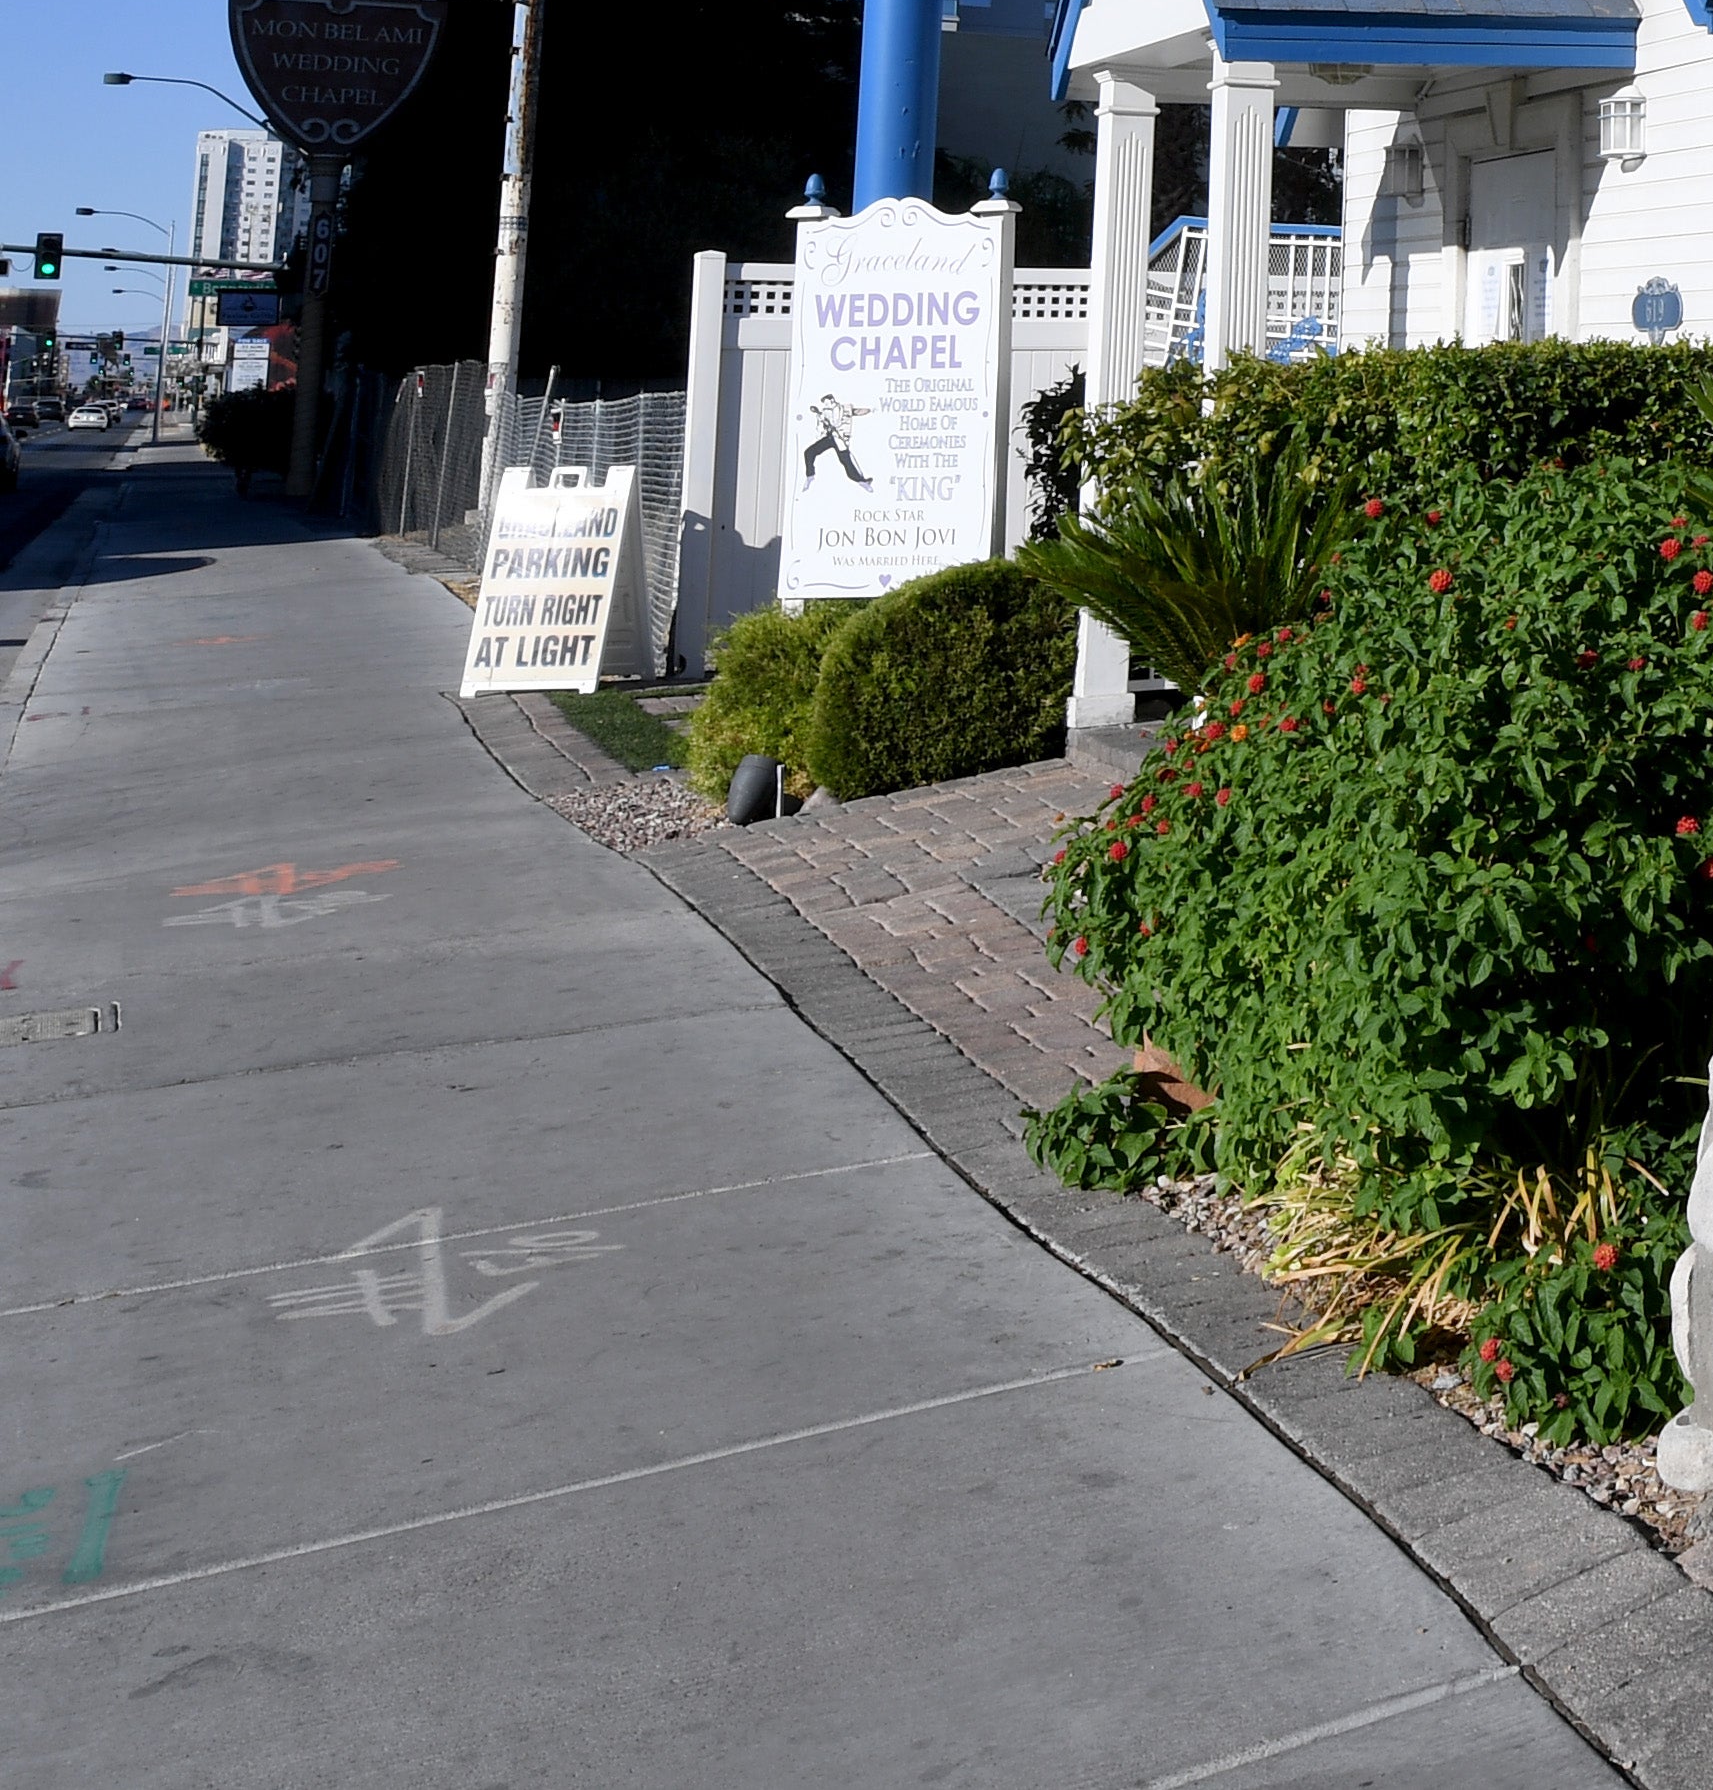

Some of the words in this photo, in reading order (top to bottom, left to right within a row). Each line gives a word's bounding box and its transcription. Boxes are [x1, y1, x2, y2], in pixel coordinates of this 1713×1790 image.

[252, 19, 318, 39] MON
[324, 23, 369, 42] BEL
[374, 26, 424, 44] AMI
[272, 52, 400, 75] WEDDING
[281, 85, 383, 106] CHAPEL
[313, 219, 329, 289] 607
[821, 233, 976, 287] Graceland
[815, 290, 980, 328] WEDDING
[1645, 299, 1664, 322] 619
[830, 335, 962, 371] CHAPEL
[885, 378, 911, 393] THE
[914, 377, 974, 392] ORIGINAL
[879, 397, 925, 412] WORLD
[929, 396, 978, 411] FAMOUS
[900, 415, 937, 431] HOME
[941, 415, 958, 430] OF
[888, 434, 967, 449] CEREMONIES
[894, 453, 929, 468] WITH
[933, 453, 958, 468] THE
[854, 509, 890, 522] ROCK
[894, 508, 924, 522] STAR
[817, 527, 855, 552] JON
[864, 526, 907, 547] BON
[914, 526, 956, 551] JOVI
[490, 547, 610, 579] PARKING
[832, 555, 855, 567] WAS
[858, 555, 908, 567] MARRIED
[911, 554, 939, 565] HERE
[483, 595, 537, 627] TURN
[540, 594, 603, 627] RIGHT
[473, 636, 509, 668] AT
[515, 635, 596, 668] LIGHT
